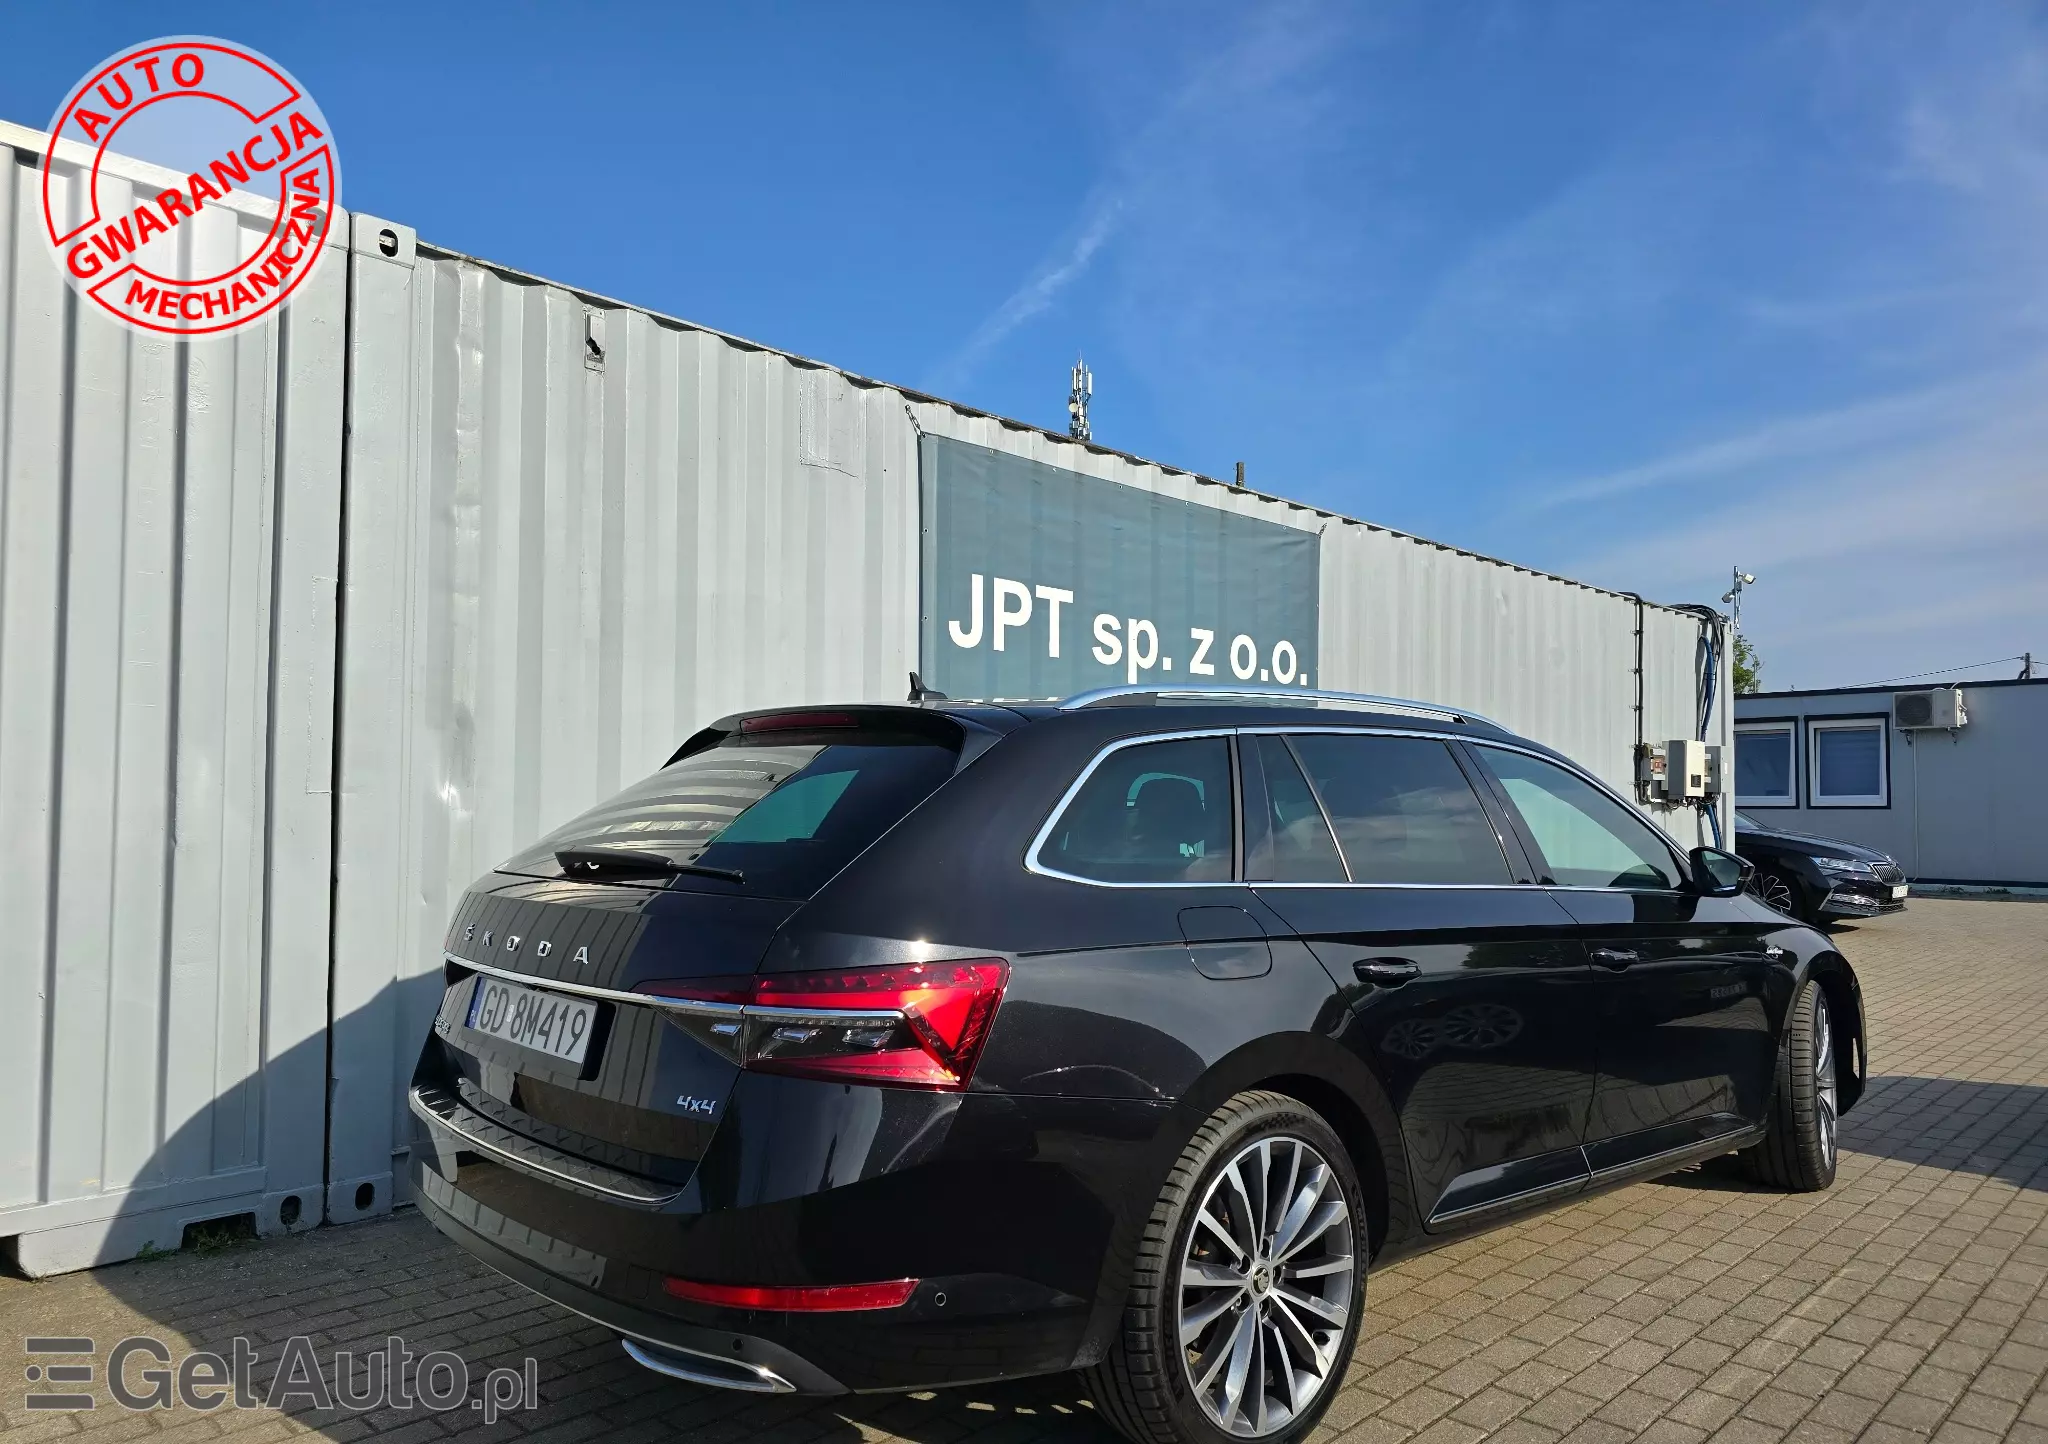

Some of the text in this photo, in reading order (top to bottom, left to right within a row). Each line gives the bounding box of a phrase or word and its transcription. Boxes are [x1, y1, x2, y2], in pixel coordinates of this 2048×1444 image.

[948, 573, 1308, 686] JPT sp. z o.o.
[480, 985, 587, 1056] GD 8M419
[676, 1095, 717, 1115] 4x4
